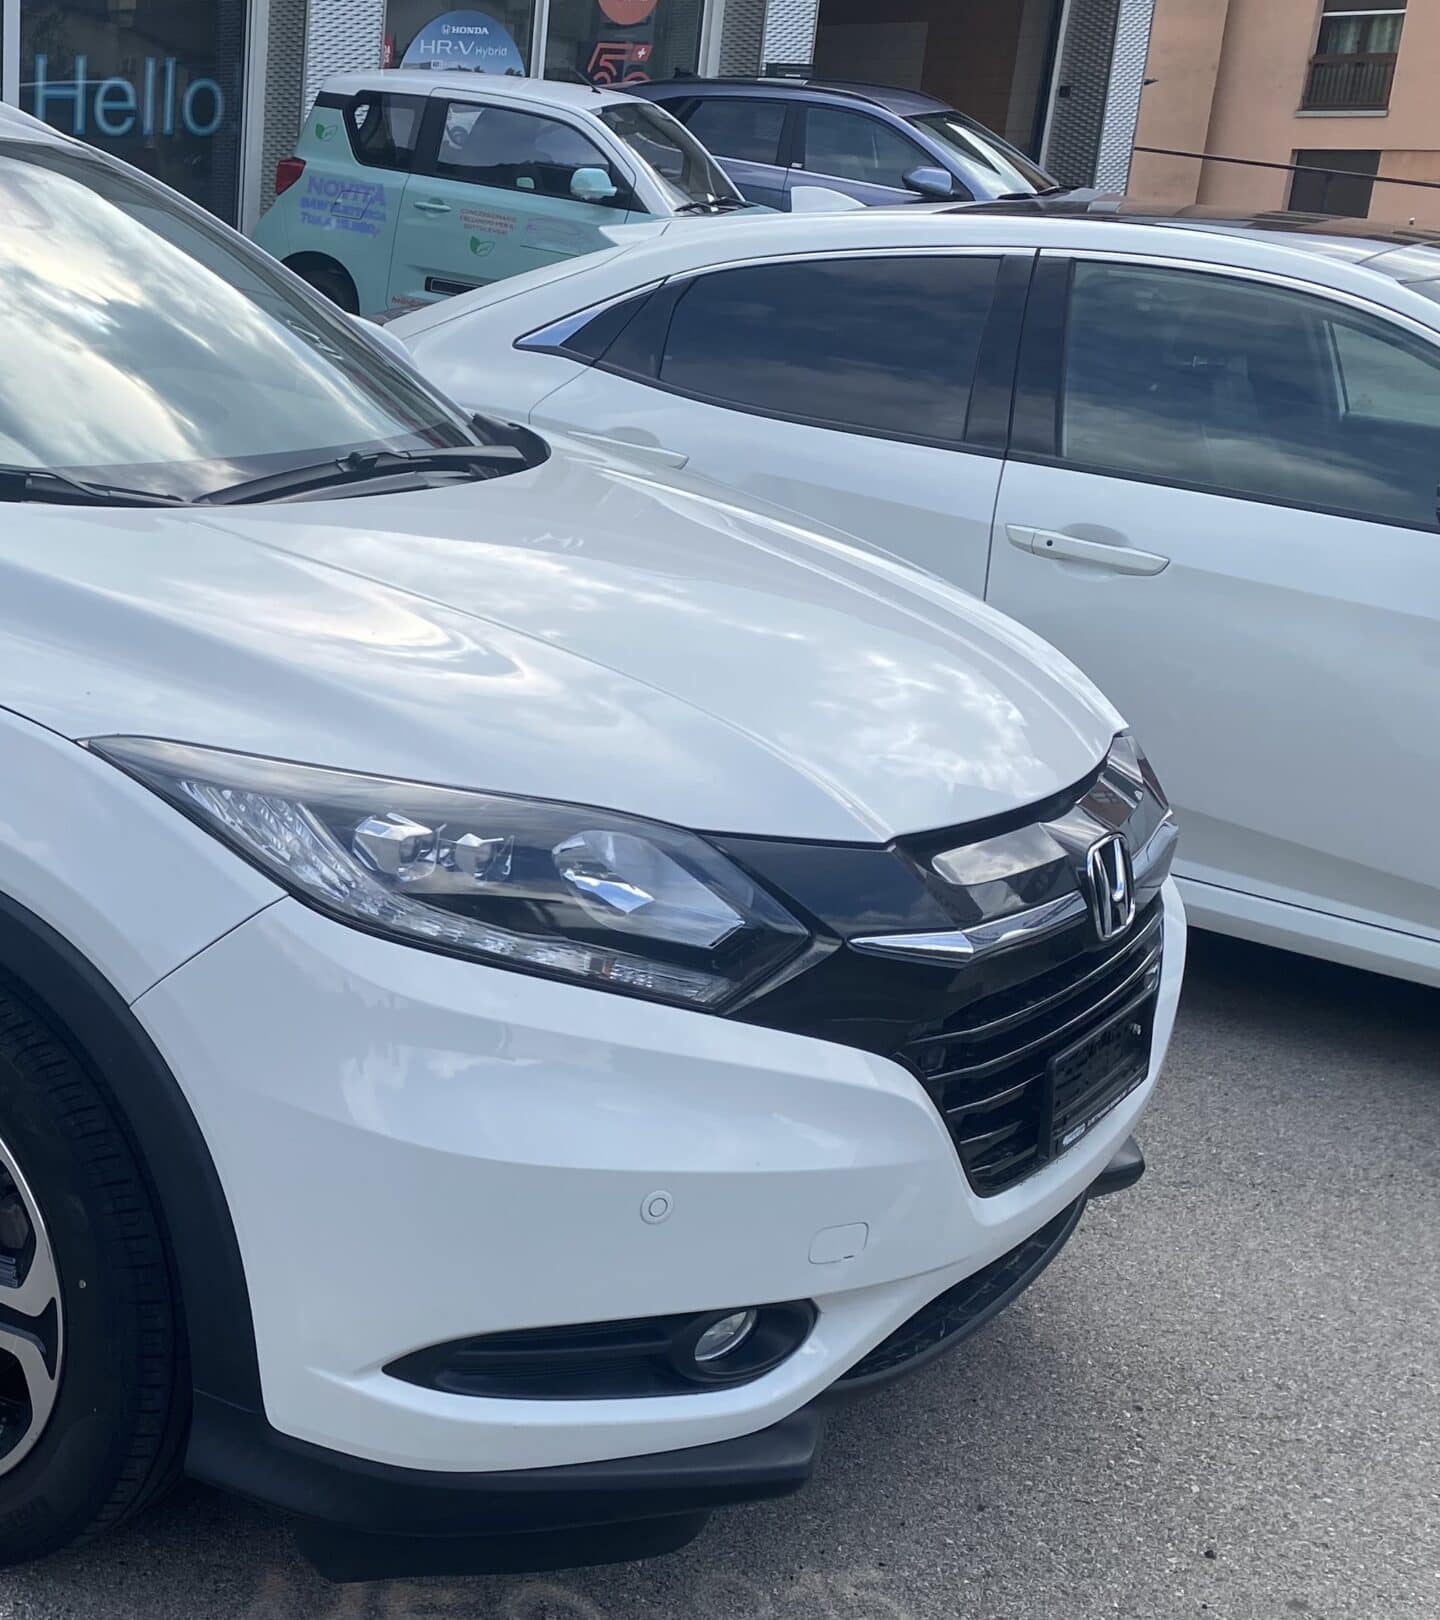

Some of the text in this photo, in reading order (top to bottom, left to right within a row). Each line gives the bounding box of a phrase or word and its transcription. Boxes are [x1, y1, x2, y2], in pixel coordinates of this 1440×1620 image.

[451, 25, 489, 35] HONDA
[420, 40, 508, 58] HR-V Hybrid
[35, 54, 225, 136] Hello
